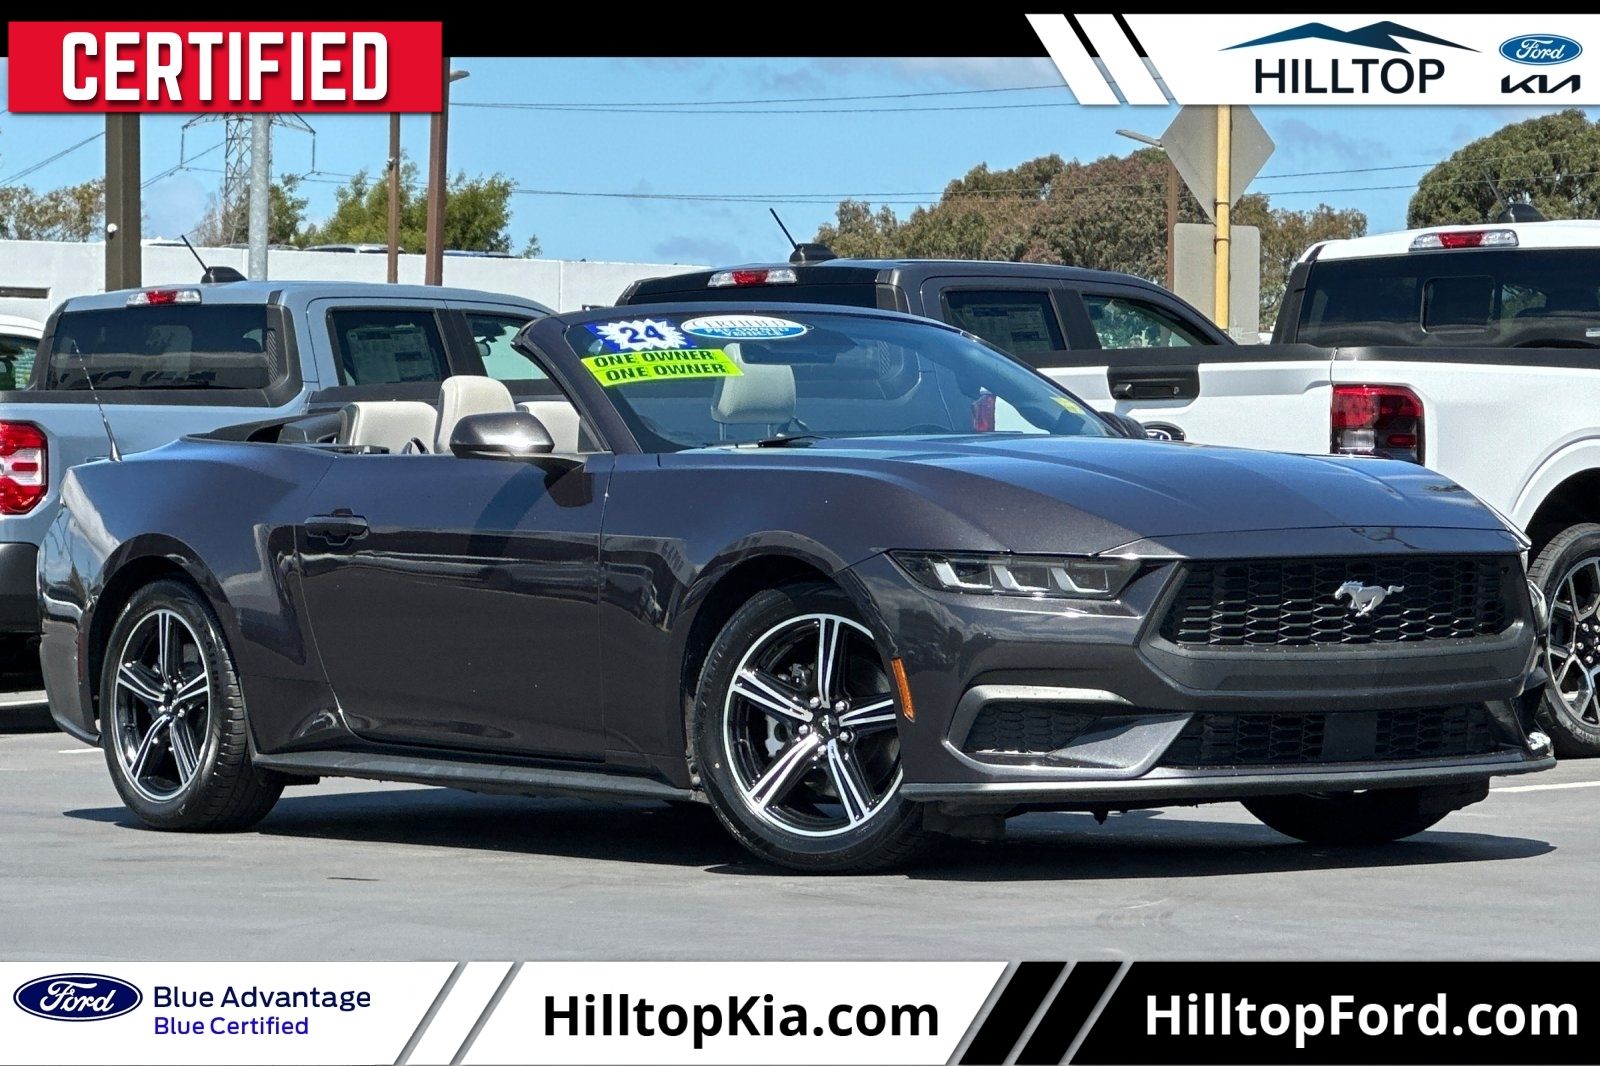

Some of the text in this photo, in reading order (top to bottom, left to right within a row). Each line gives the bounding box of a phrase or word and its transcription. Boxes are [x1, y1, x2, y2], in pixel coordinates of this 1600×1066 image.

[619, 325, 666, 344] 24
[593, 350, 714, 368] ONE OWNER
[605, 363, 727, 381] ONE OWNER
